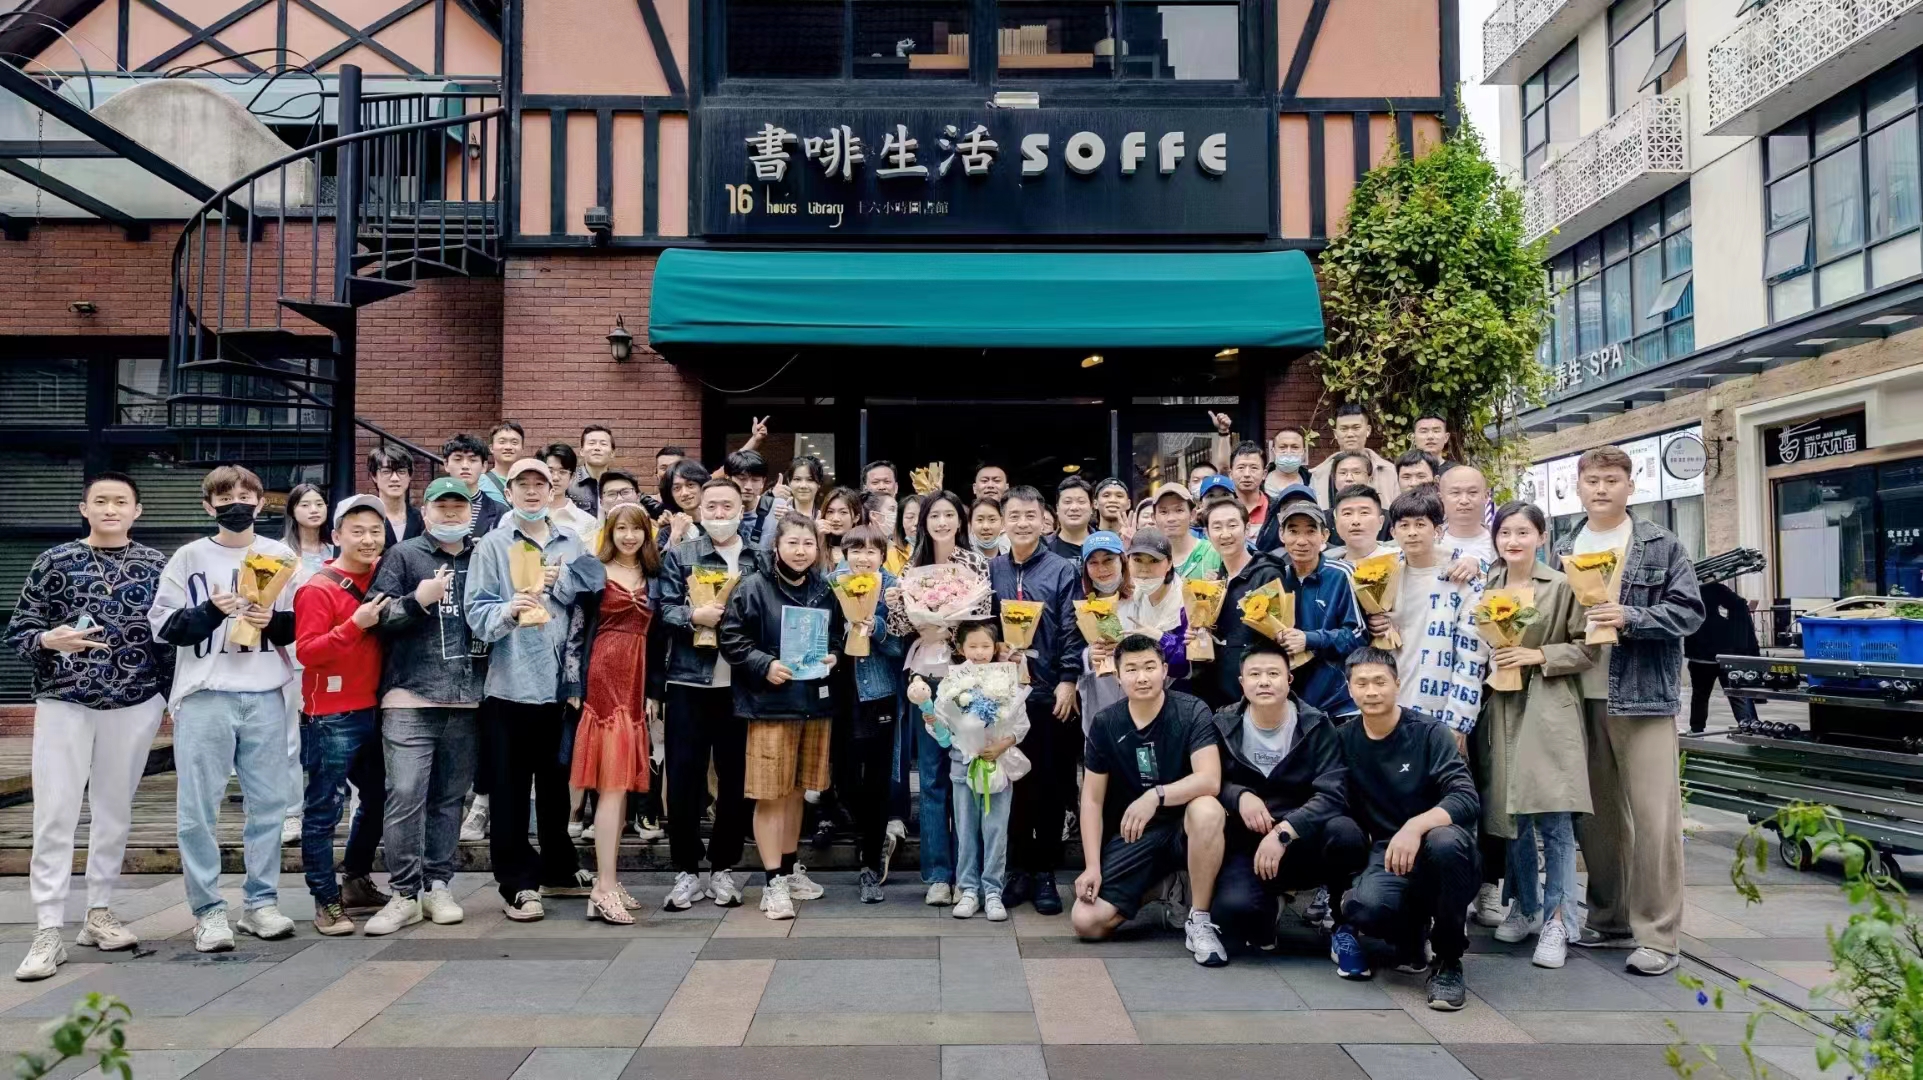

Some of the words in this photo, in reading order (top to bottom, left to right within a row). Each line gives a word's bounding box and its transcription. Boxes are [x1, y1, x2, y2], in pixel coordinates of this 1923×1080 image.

[745, 123, 999, 182] 書啡生活
[1021, 131, 1227, 176] SOFFE
[725, 183, 754, 214] 16
[766, 184, 798, 214] hours
[1590, 344, 1623, 375] SPA
[1804, 434, 1857, 459] 初次见面
